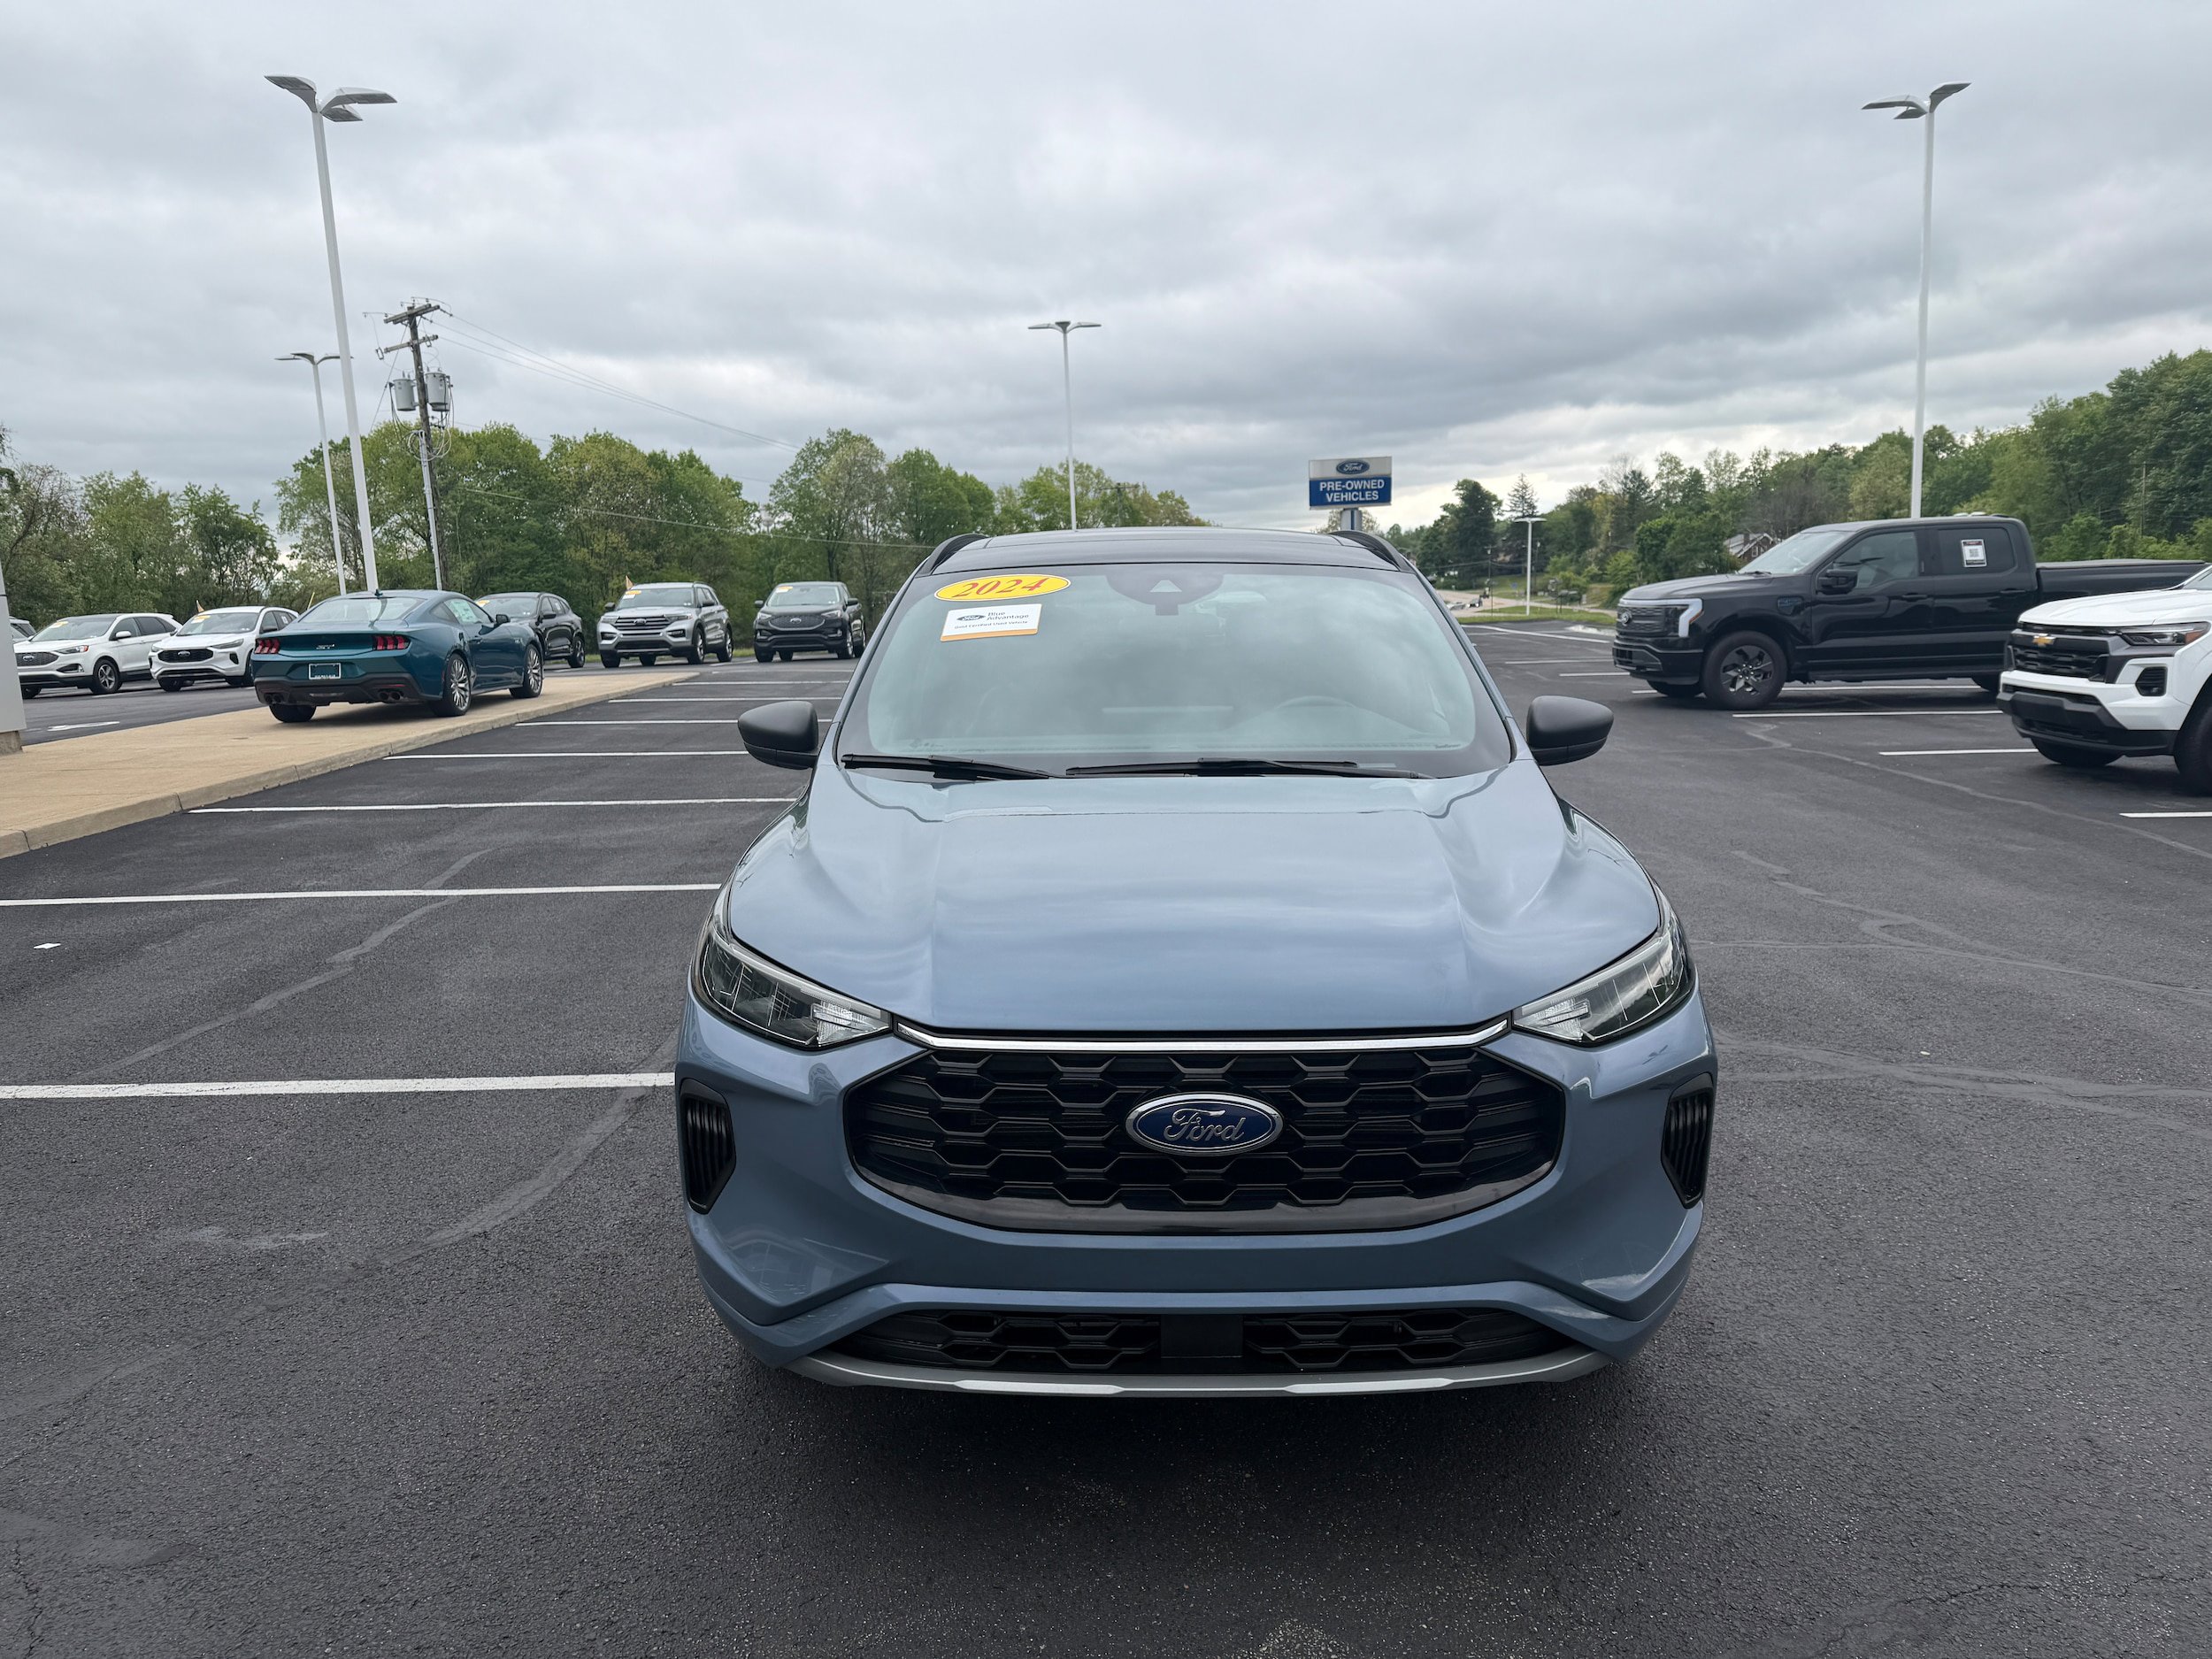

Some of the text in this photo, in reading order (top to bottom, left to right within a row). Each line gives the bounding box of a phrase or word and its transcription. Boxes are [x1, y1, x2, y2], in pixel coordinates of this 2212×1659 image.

[1343, 462, 1363, 472] Ford
[1319, 480, 1385, 491] PRE-OWNED
[1325, 491, 1379, 503] VEHICLES
[952, 577, 1050, 598] 2024
[1164, 1108, 1247, 1141] Ford
